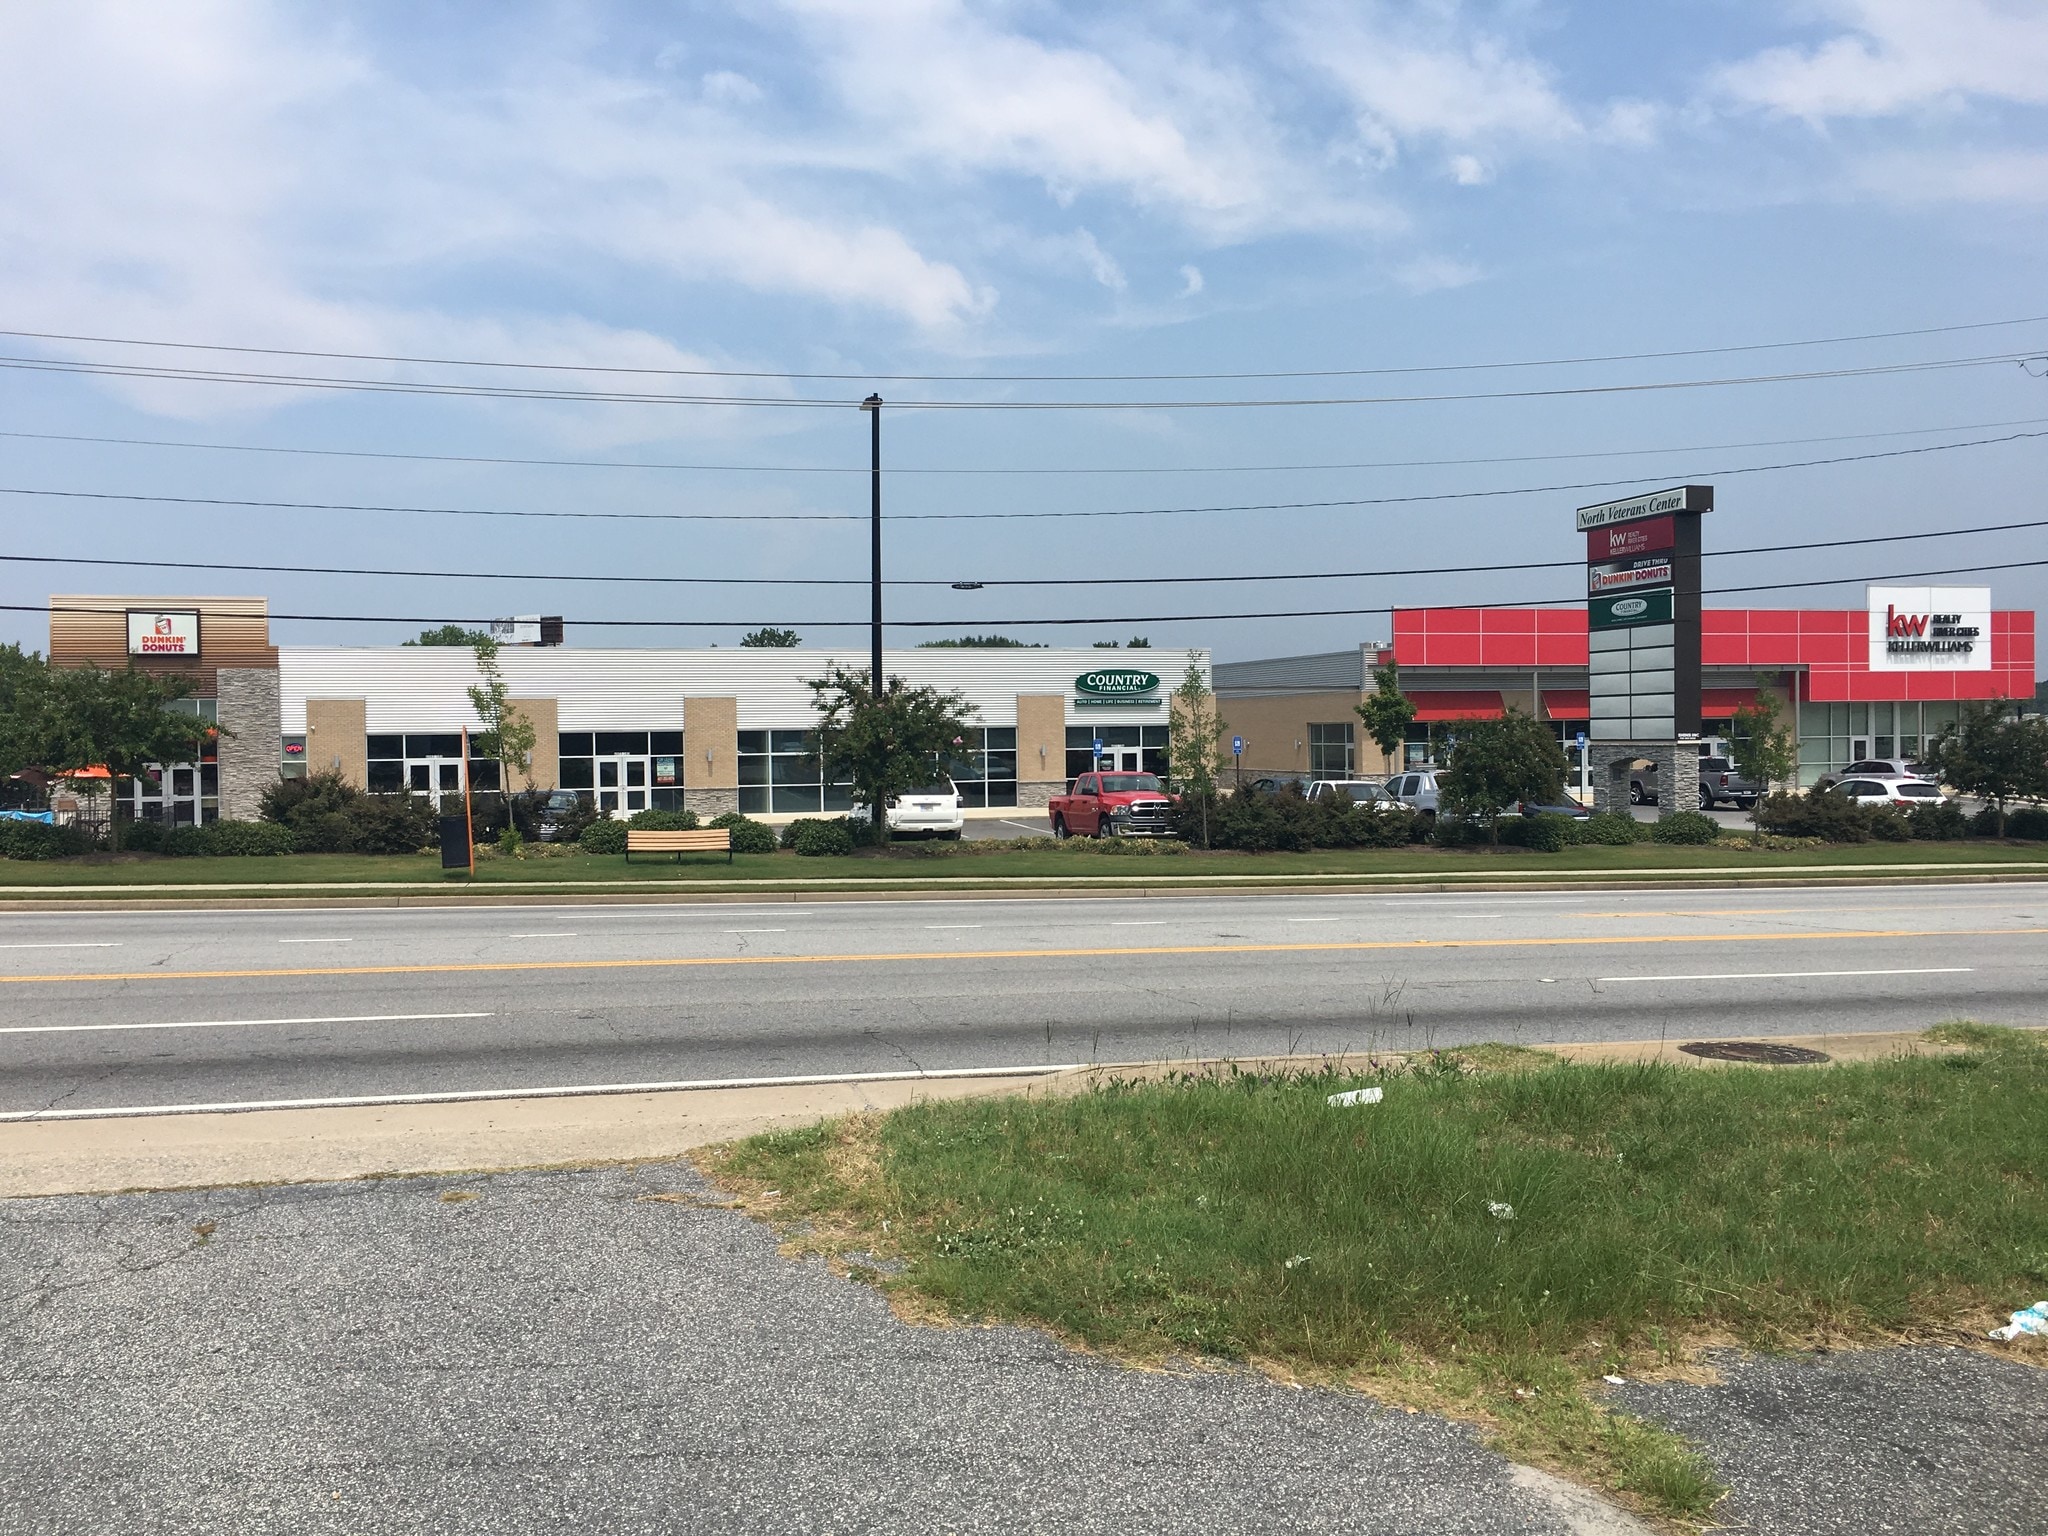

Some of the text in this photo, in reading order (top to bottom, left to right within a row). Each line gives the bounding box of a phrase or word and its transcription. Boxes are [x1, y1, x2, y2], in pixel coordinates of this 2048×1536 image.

[1580, 496, 1682, 527] North Veterans Center
[1609, 529, 1627, 547] kw
[1633, 558, 1669, 569] DRIVE THRU
[1602, 566, 1668, 586] DUNKIN' DONUTS
[1615, 600, 1643, 611] COUNTRY
[1887, 604, 1930, 637] kw
[1932, 614, 1963, 624] REALTY
[1932, 626, 1956, 637] RIVER
[142, 636, 186, 644] DUNKIN'
[142, 644, 185, 652] DONUTS
[1887, 641, 1974, 653] KELLERWILLIAMS
[1087, 674, 1149, 686] COUNTRY
